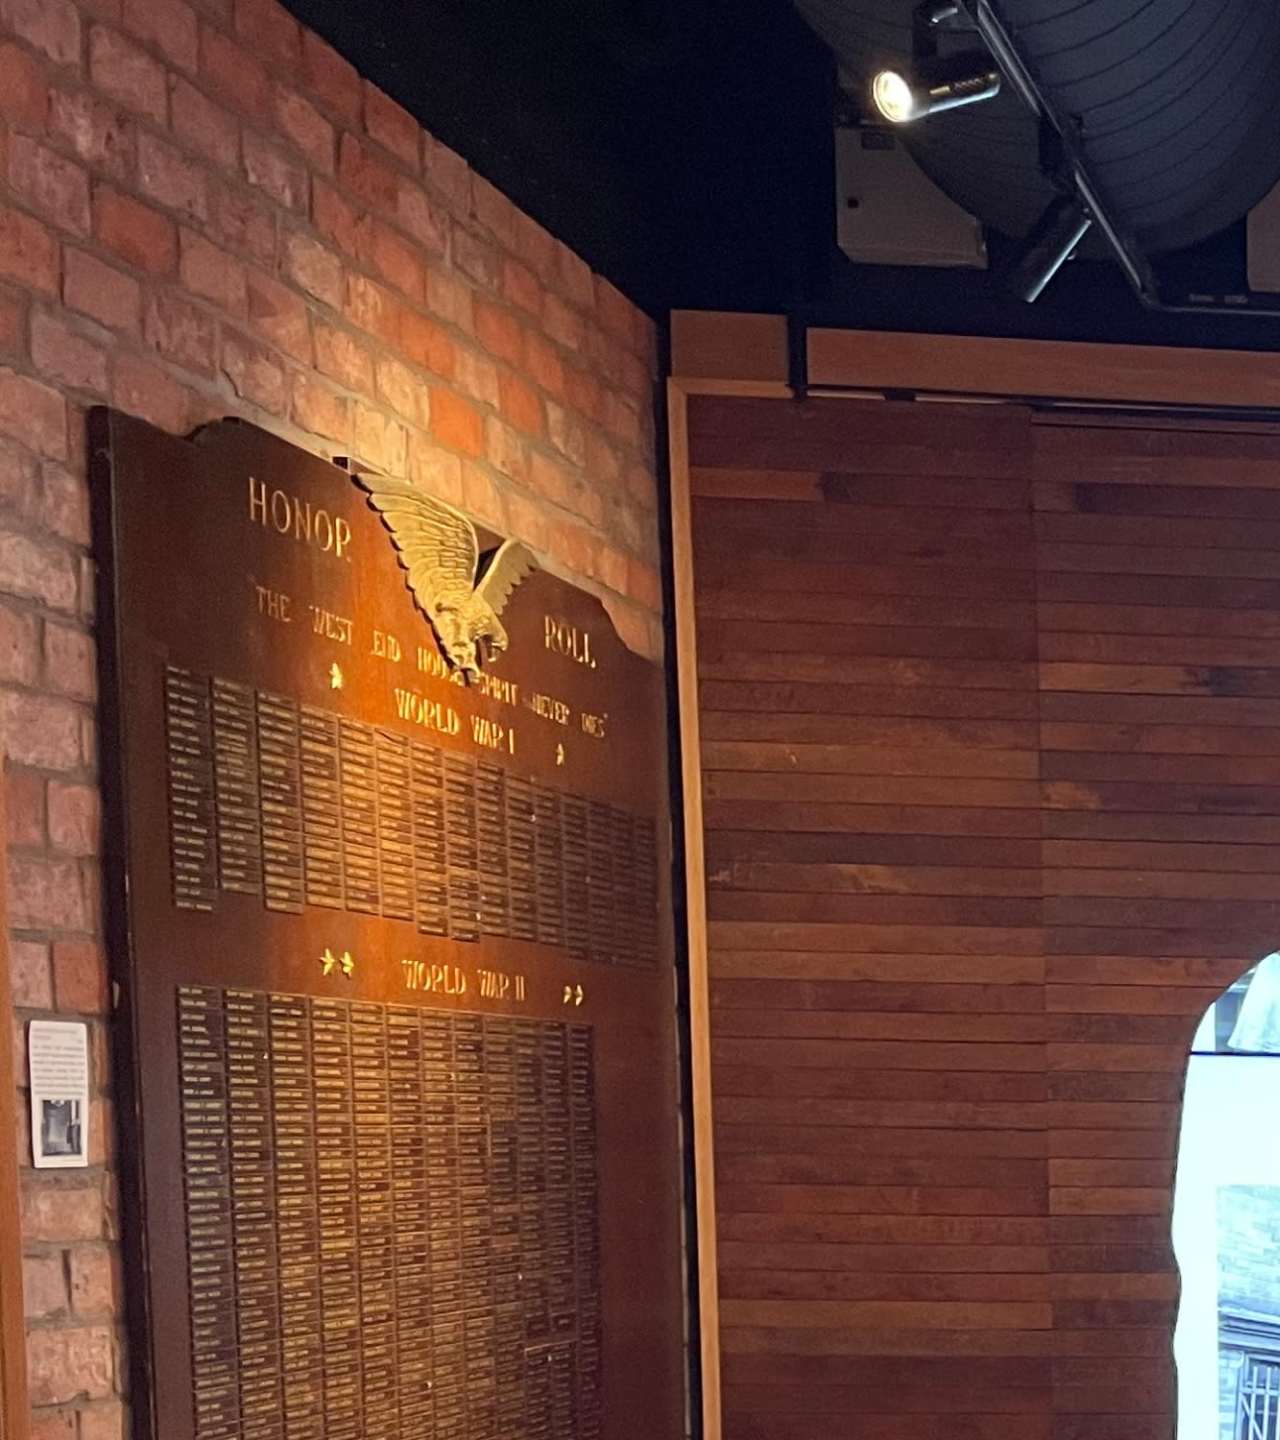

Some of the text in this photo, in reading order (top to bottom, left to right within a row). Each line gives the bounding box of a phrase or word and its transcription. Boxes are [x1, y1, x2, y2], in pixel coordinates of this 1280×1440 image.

[249, 476, 351, 562] HONOR
[256, 585, 291, 622] THE
[309, 605, 352, 646] WEST
[370, 630, 401, 662] END
[394, 687, 514, 754] WORLD WAR I
[401, 959, 525, 1000] WORLD WAR II
